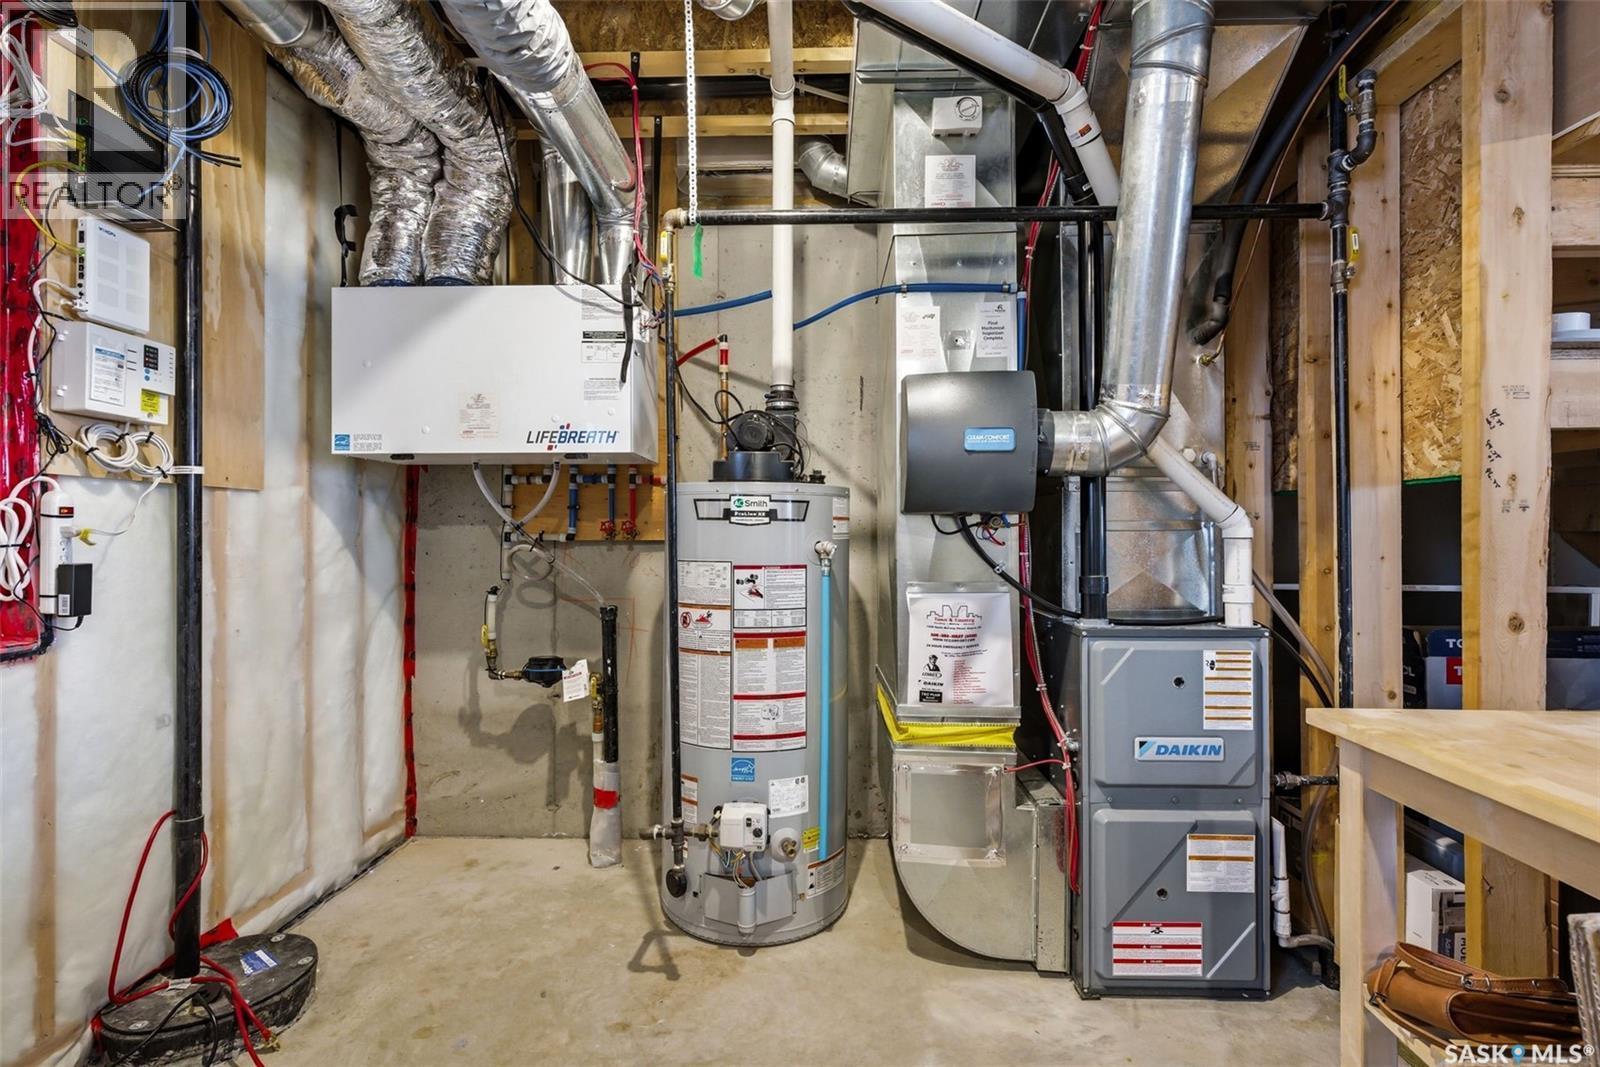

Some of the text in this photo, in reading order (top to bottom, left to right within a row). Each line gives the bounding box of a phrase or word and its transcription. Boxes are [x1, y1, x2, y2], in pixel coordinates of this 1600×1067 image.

[526, 430, 618, 444] LIFEBREATH
[744, 499, 768, 508] Smith
[1155, 744, 1222, 756] DAIKIN
